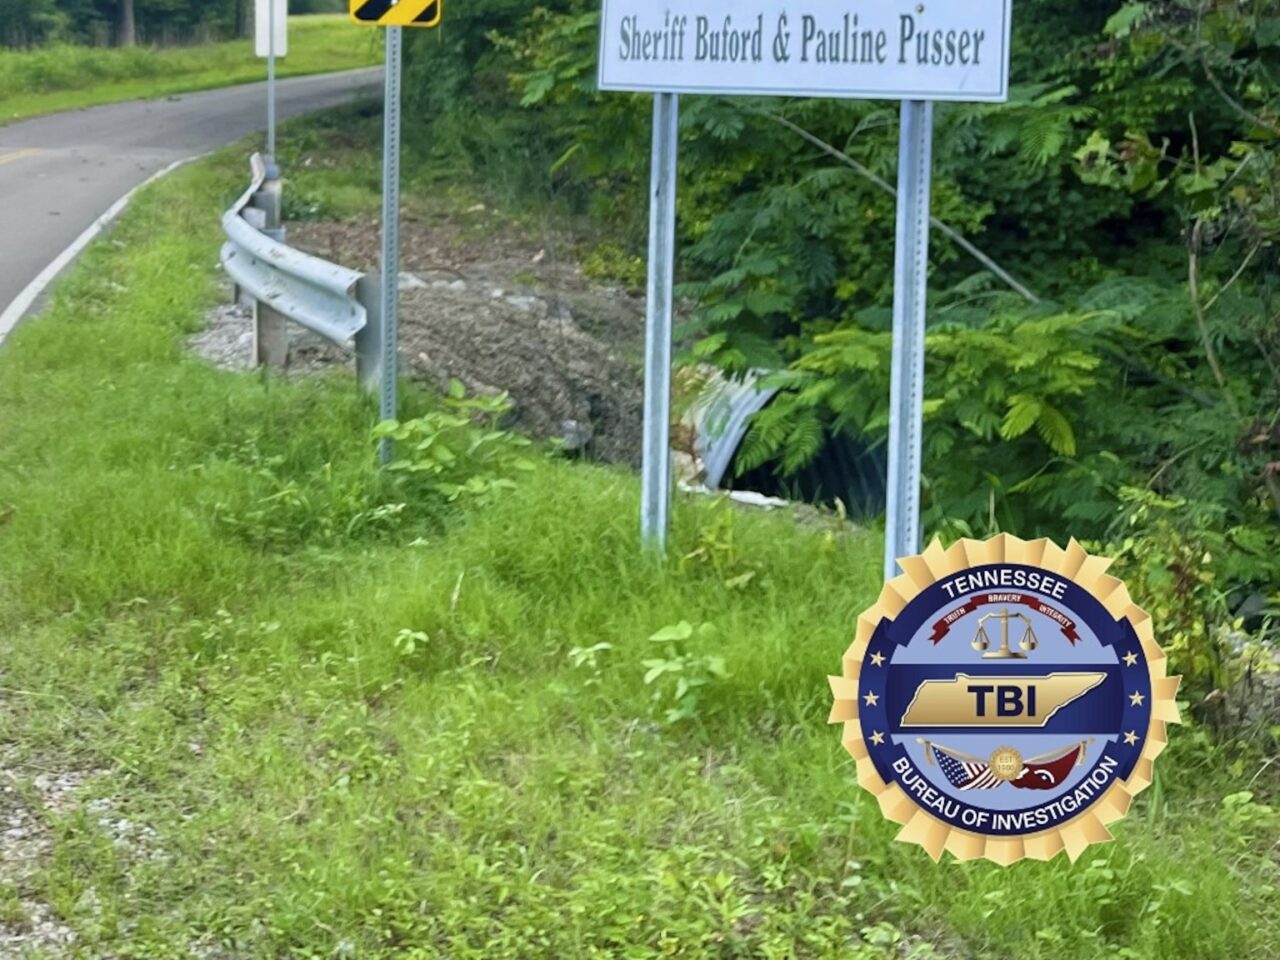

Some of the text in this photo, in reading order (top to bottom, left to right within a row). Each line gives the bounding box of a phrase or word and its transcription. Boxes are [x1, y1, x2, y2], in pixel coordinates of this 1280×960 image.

[618, 11, 985, 66] Sheriff Buford & Pauline Pusser
